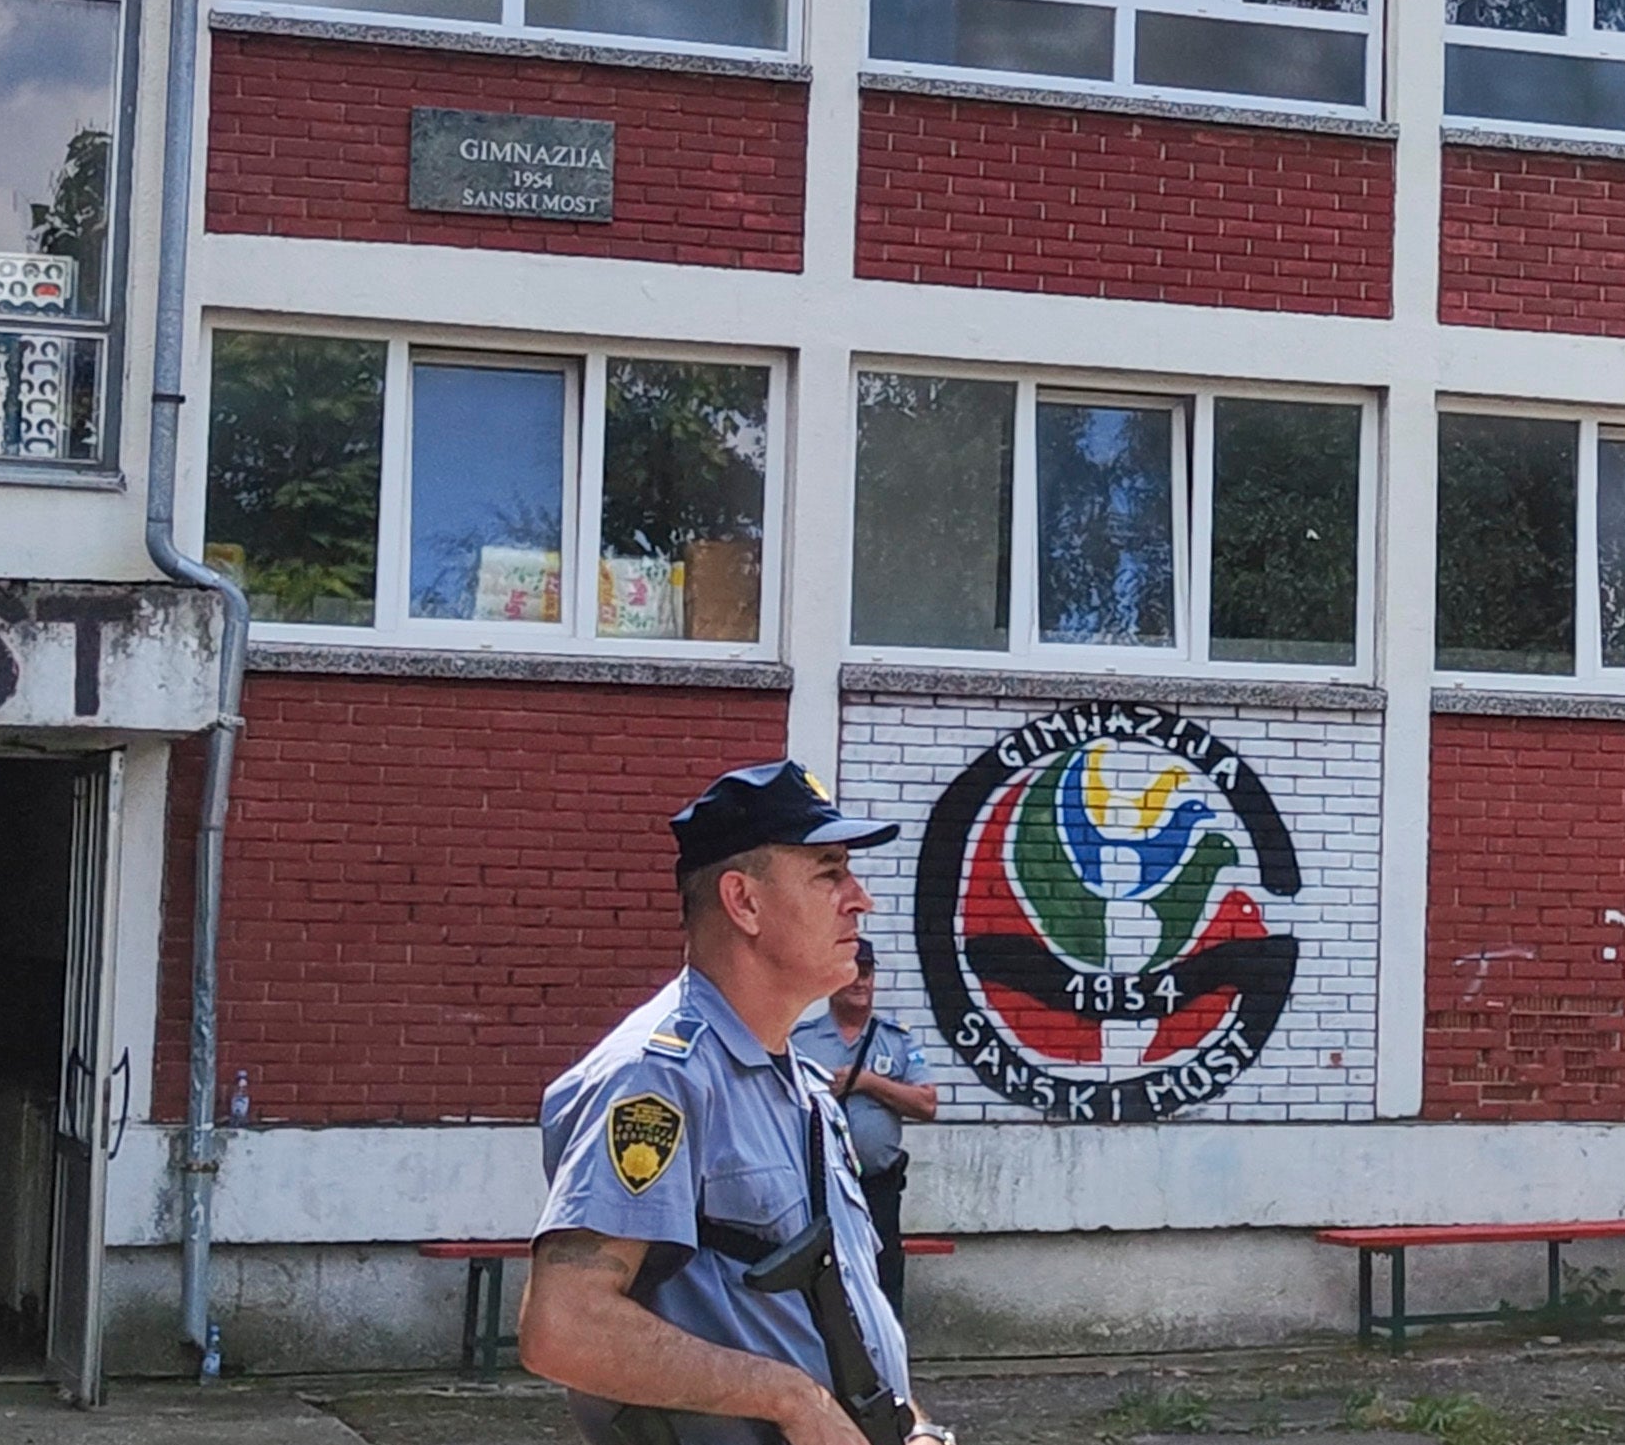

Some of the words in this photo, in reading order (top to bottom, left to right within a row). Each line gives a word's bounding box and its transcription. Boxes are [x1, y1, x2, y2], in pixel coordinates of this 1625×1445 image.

[460, 139, 606, 169] GIMNAZIJA
[514, 170, 553, 189] 1954
[462, 189, 538, 210] SANSKI
[542, 195, 600, 213] MOST
[999, 703, 1240, 792] GIMNAZIJA
[1065, 975, 1183, 1015] 1954
[956, 1011, 1121, 1121] SANSKI
[1145, 1020, 1256, 1114] MOST
